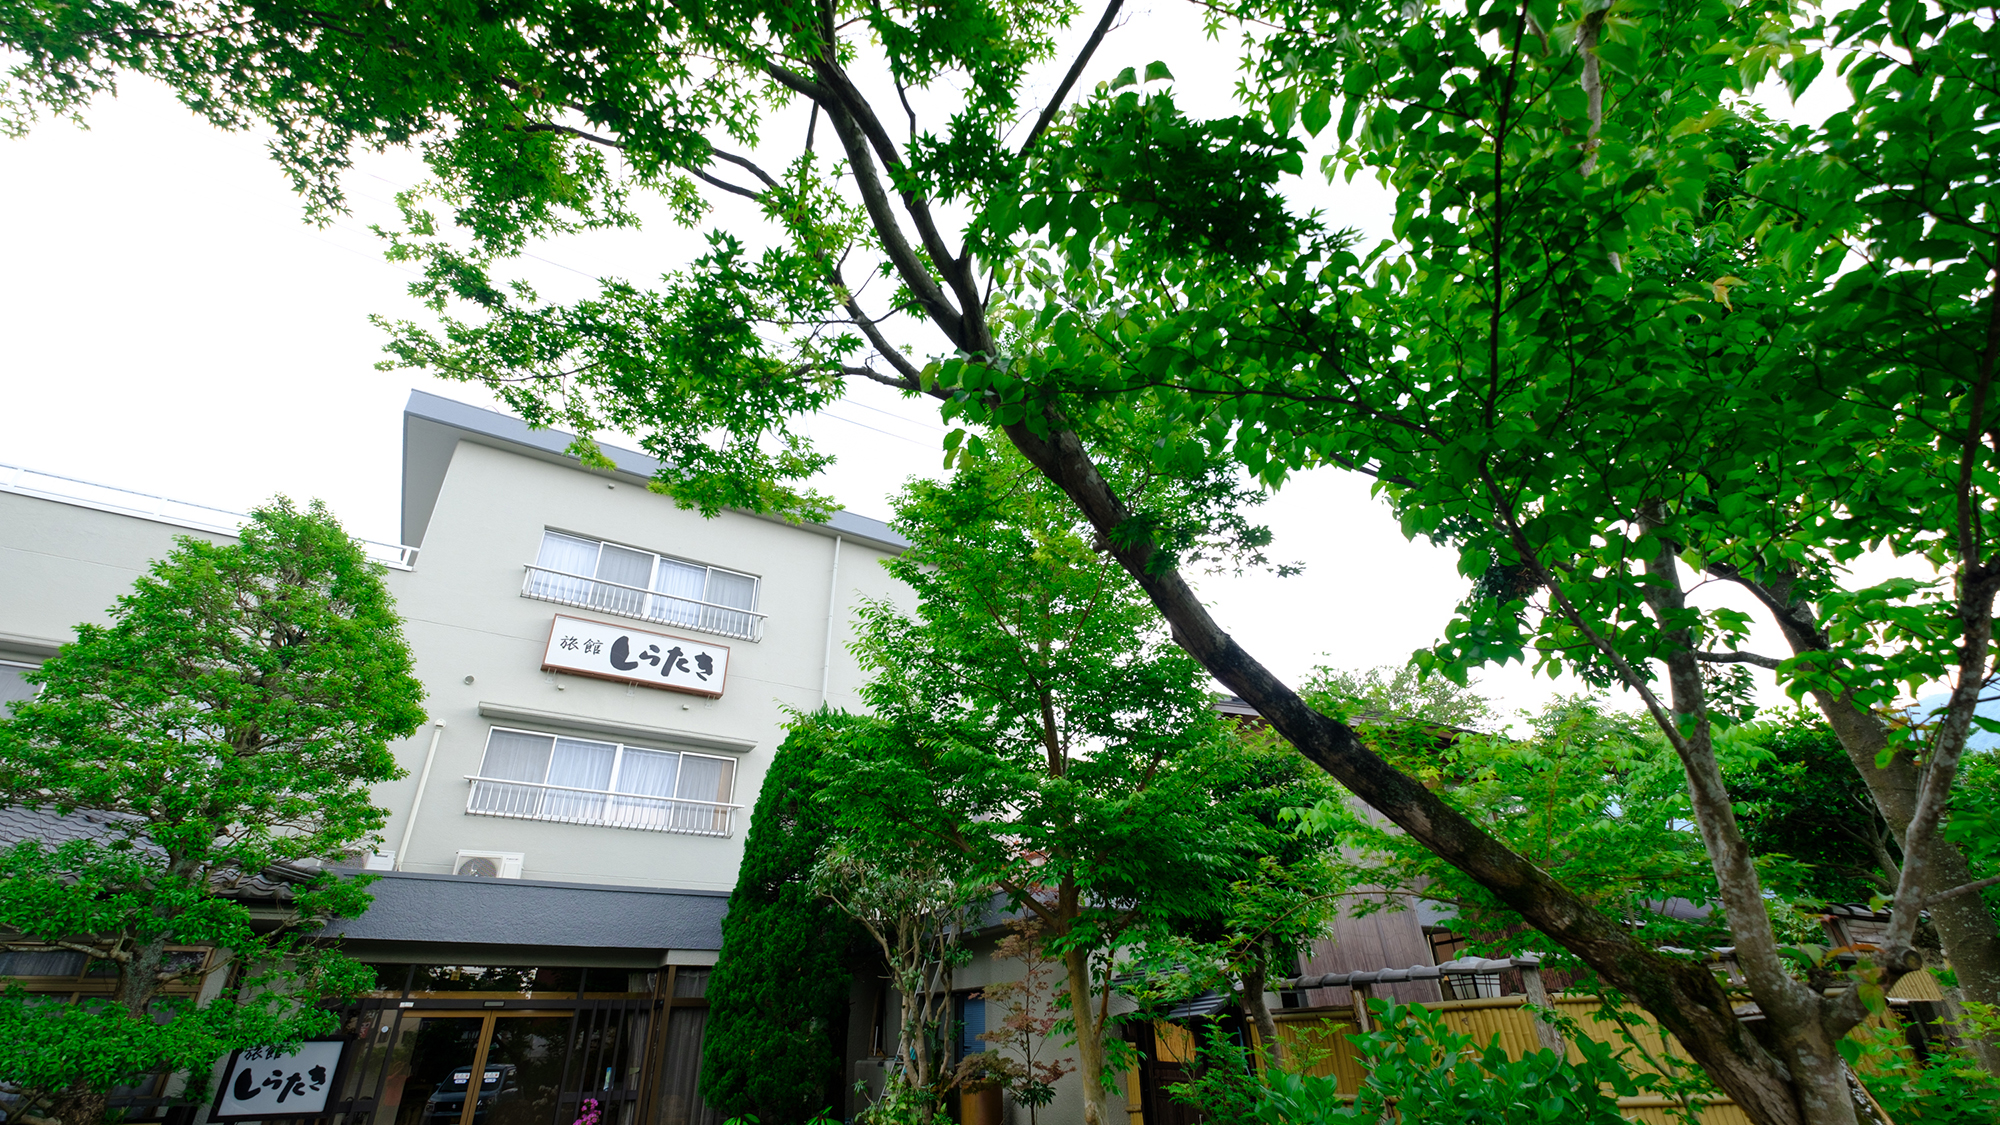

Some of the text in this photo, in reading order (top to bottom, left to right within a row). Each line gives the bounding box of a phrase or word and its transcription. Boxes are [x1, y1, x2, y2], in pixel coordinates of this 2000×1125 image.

[560, 635, 714, 682] 旅館 しらたき
[234, 1064, 326, 1103] しらたき
